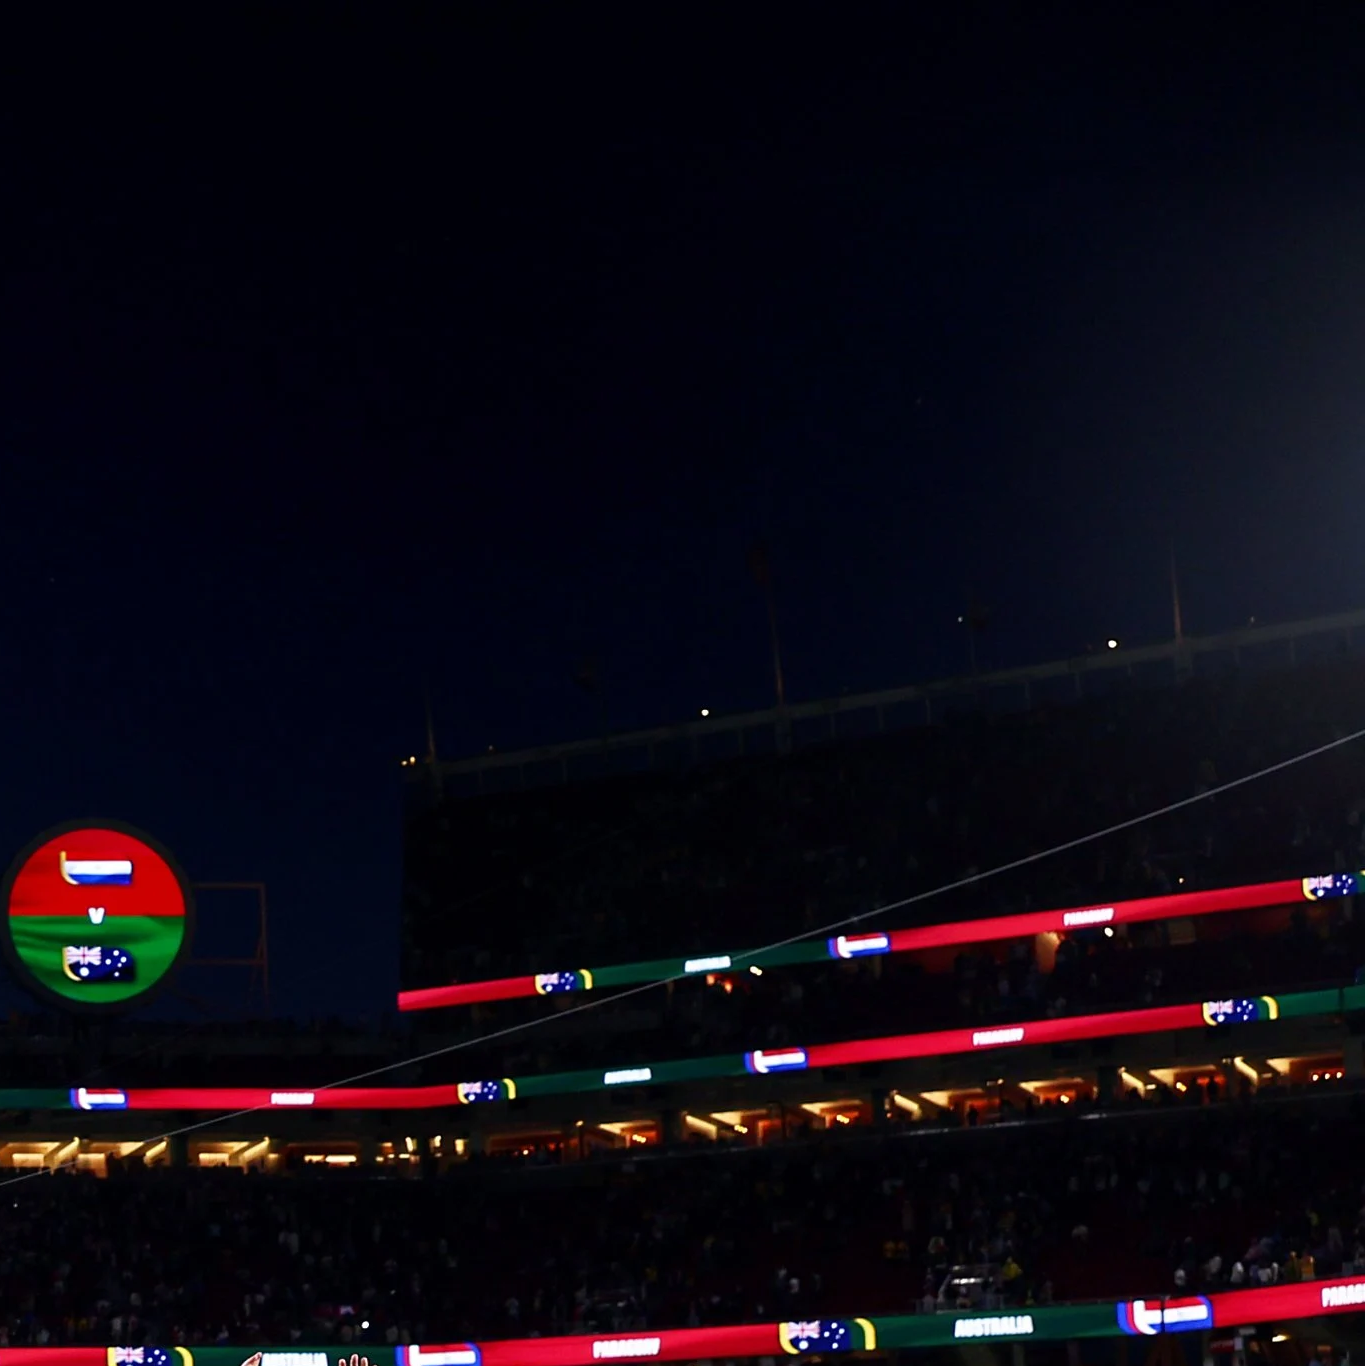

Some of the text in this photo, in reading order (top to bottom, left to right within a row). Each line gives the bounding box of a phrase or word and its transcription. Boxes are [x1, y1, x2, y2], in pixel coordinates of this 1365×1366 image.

[1322, 1283, 1365, 1307] PARAG
[955, 1315, 1033, 1337] AUSTRALIA
[593, 1338, 660, 1358] PARAGUAY
